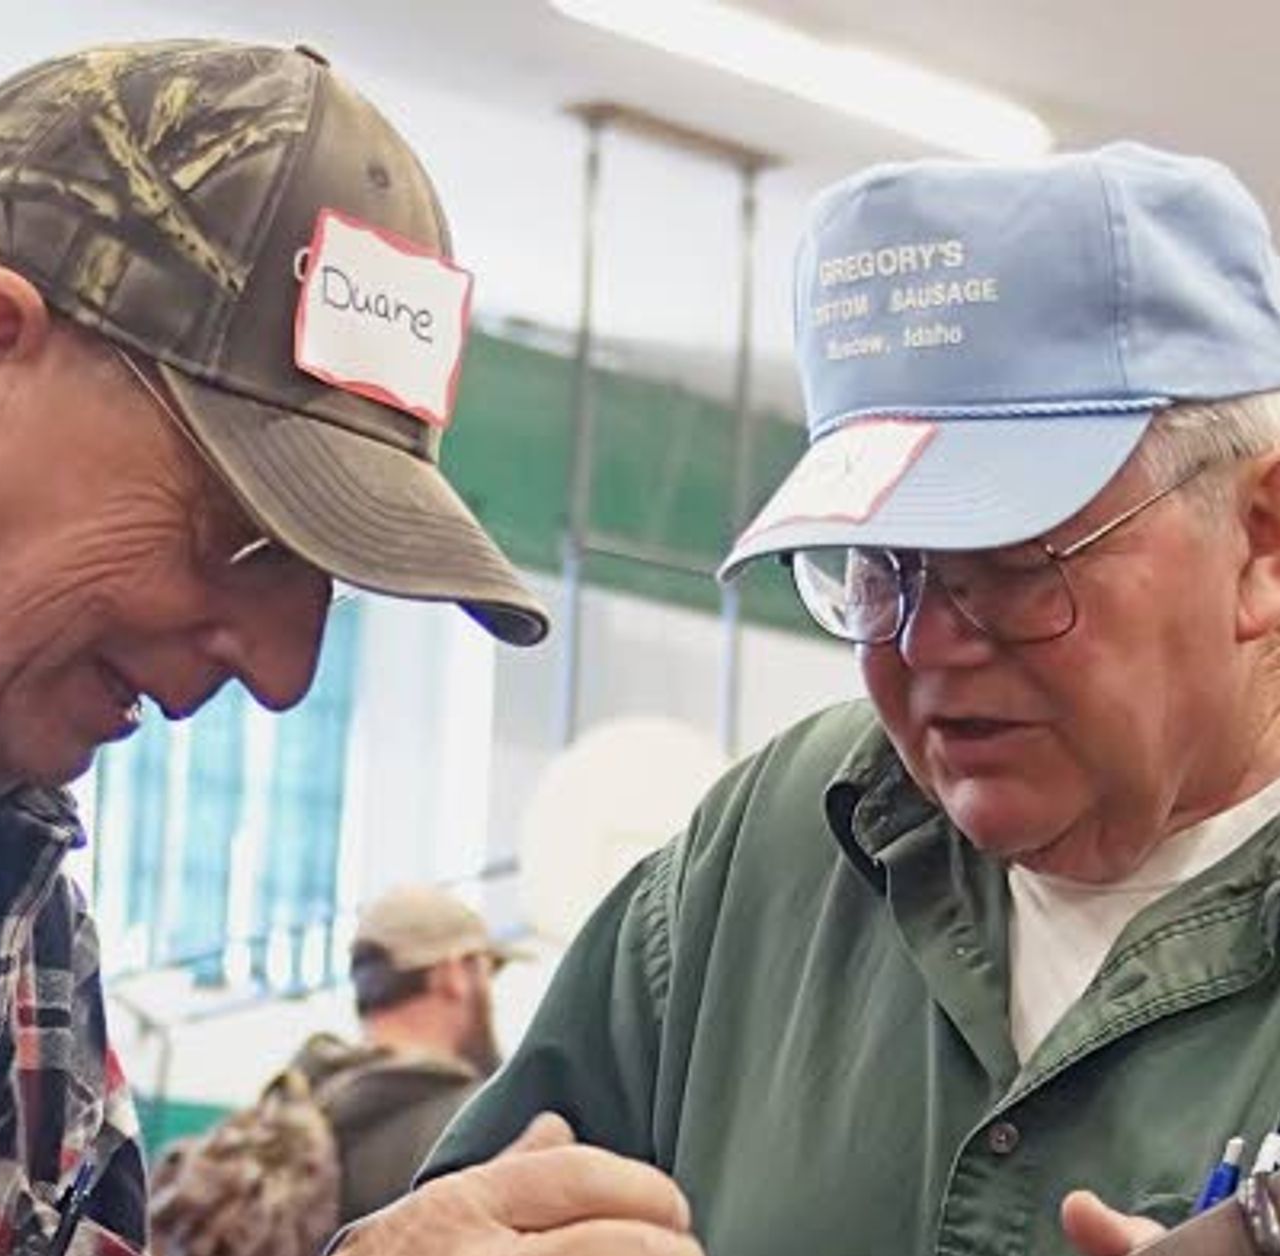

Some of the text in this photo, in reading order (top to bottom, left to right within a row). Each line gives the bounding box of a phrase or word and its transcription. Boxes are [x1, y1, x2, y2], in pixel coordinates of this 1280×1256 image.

[820, 240, 964, 287] GREGORY'S
[322, 265, 434, 344] Duane
[813, 278, 1000, 327] STOM SAUSAGE
[904, 322, 964, 349] Idaho
